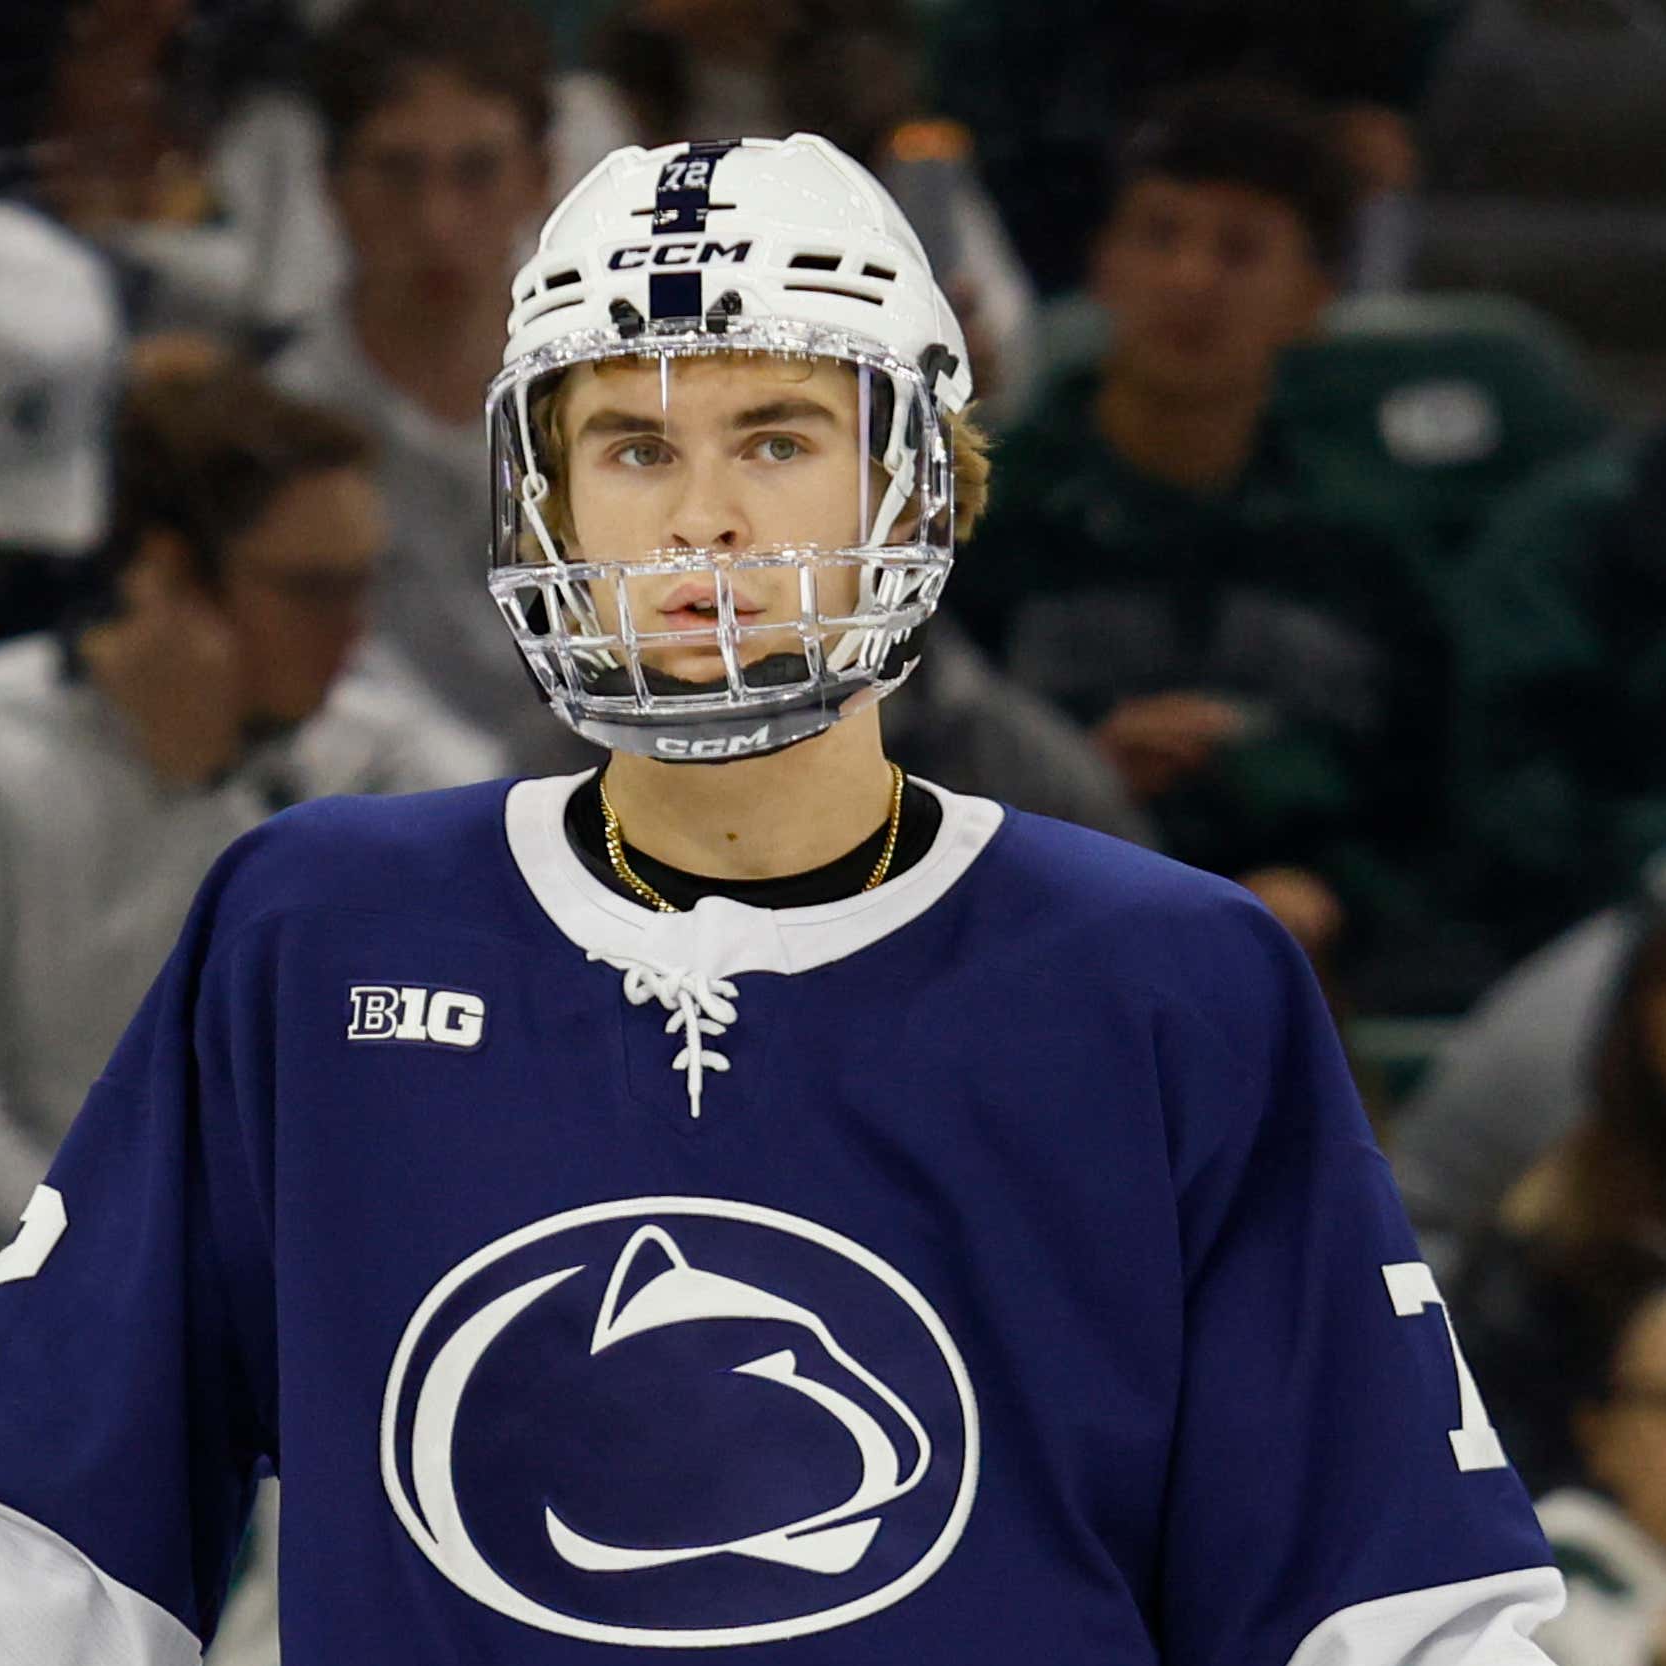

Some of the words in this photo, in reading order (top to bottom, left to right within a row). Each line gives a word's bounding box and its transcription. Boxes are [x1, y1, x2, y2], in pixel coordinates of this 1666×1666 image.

[663, 160, 710, 189] 72
[608, 241, 753, 271] CCM
[655, 724, 770, 756] CCM
